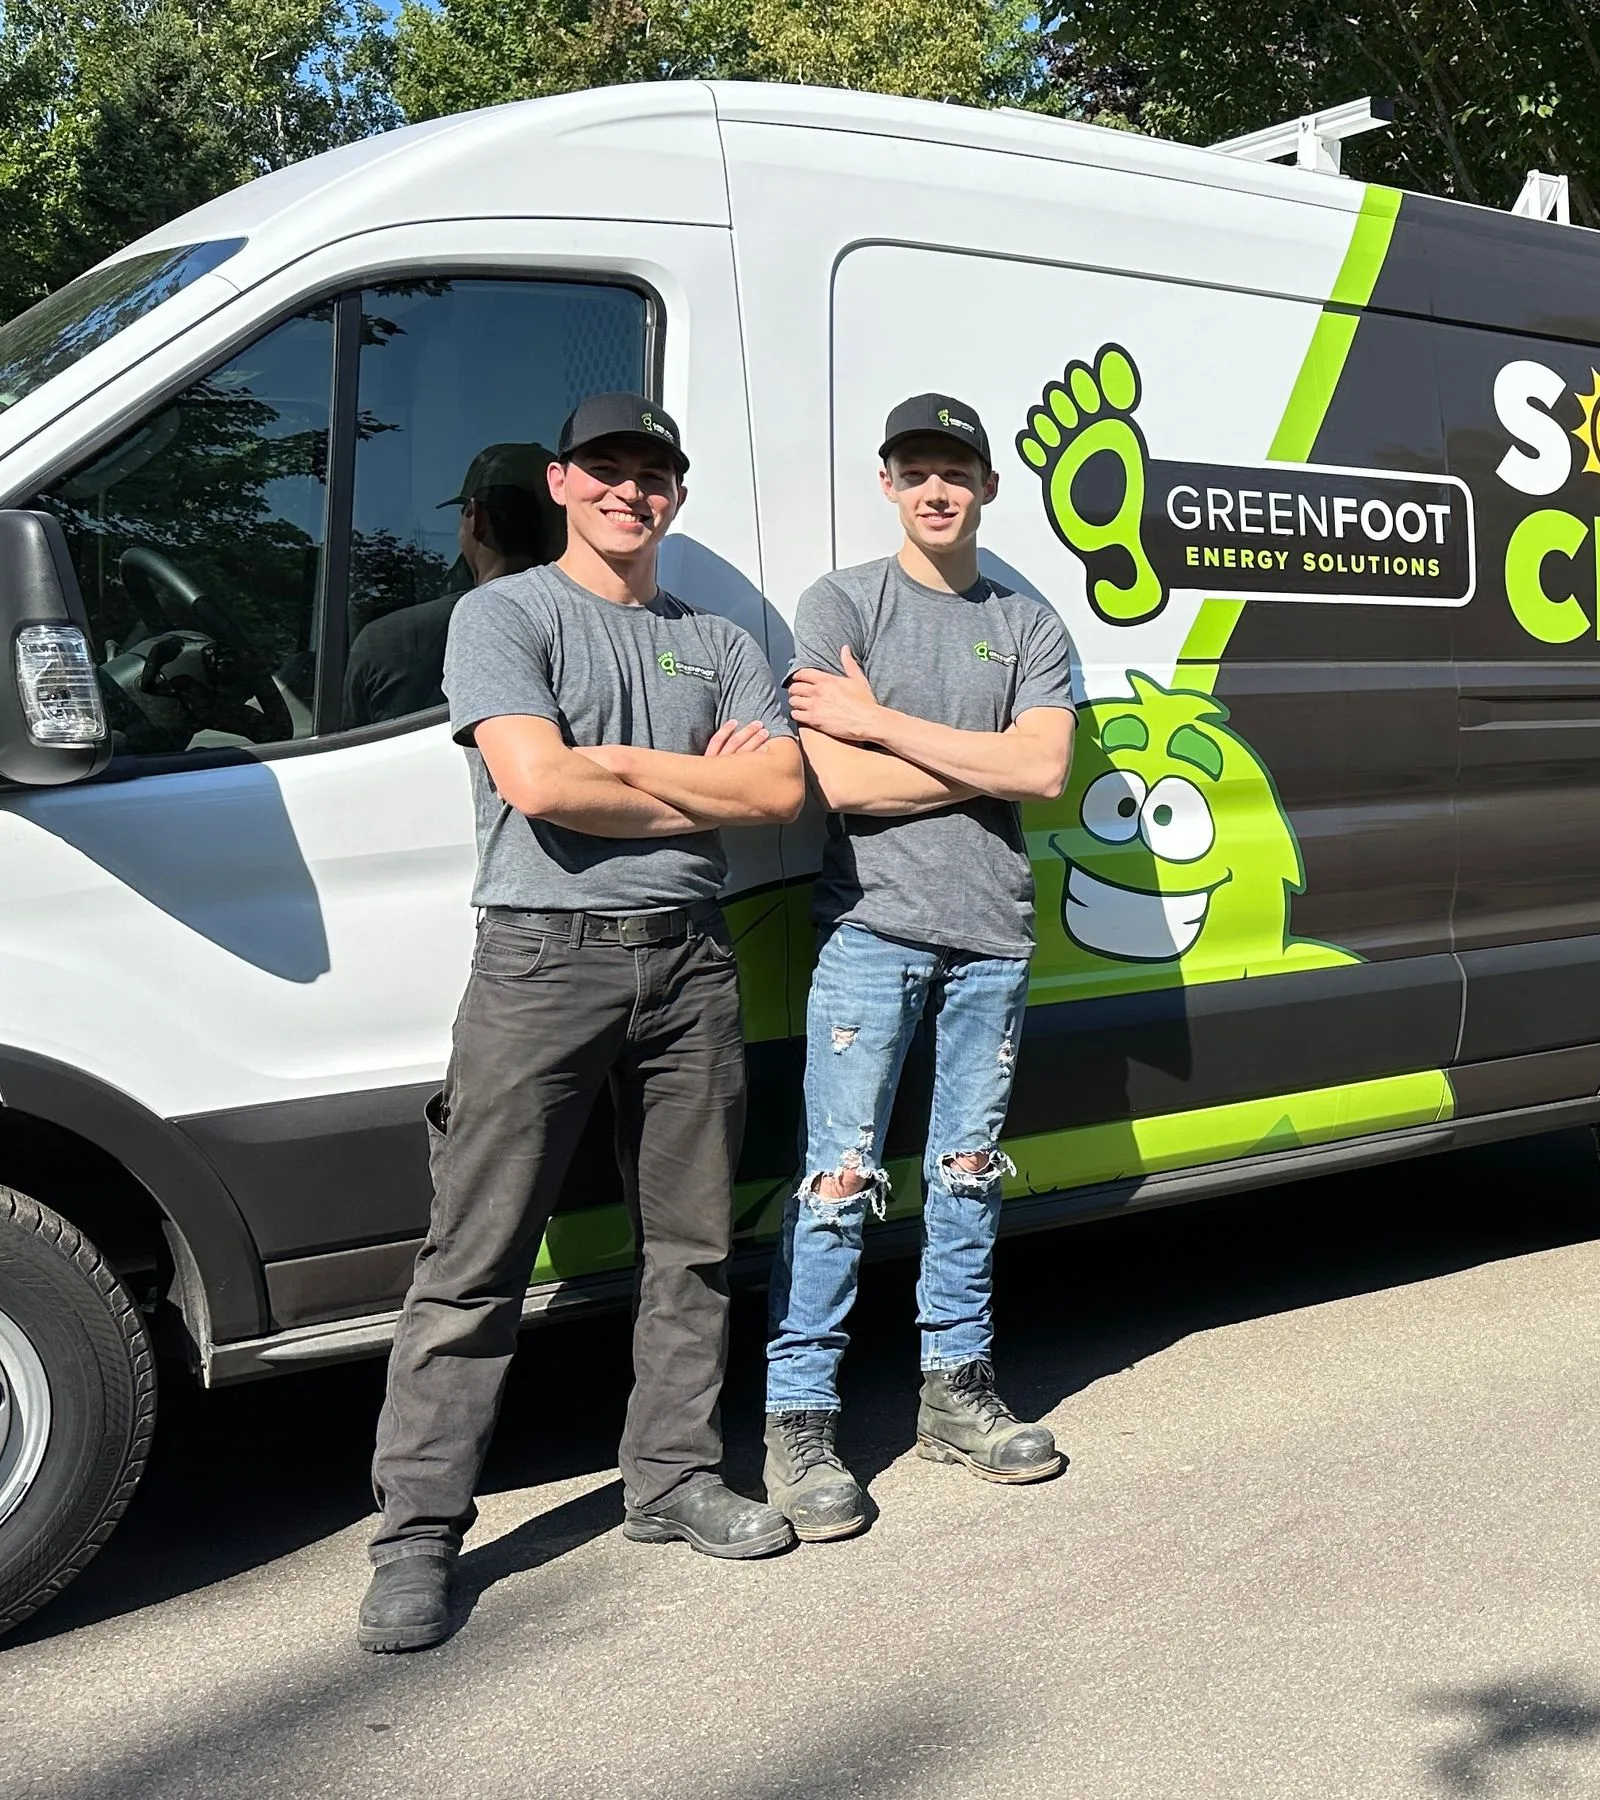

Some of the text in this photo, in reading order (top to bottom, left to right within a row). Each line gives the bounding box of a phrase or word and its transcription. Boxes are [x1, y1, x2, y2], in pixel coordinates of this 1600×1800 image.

[1166, 484, 1452, 545] GREENFOOT
[1185, 546, 1442, 578] ENERGY SOLUTIONS
